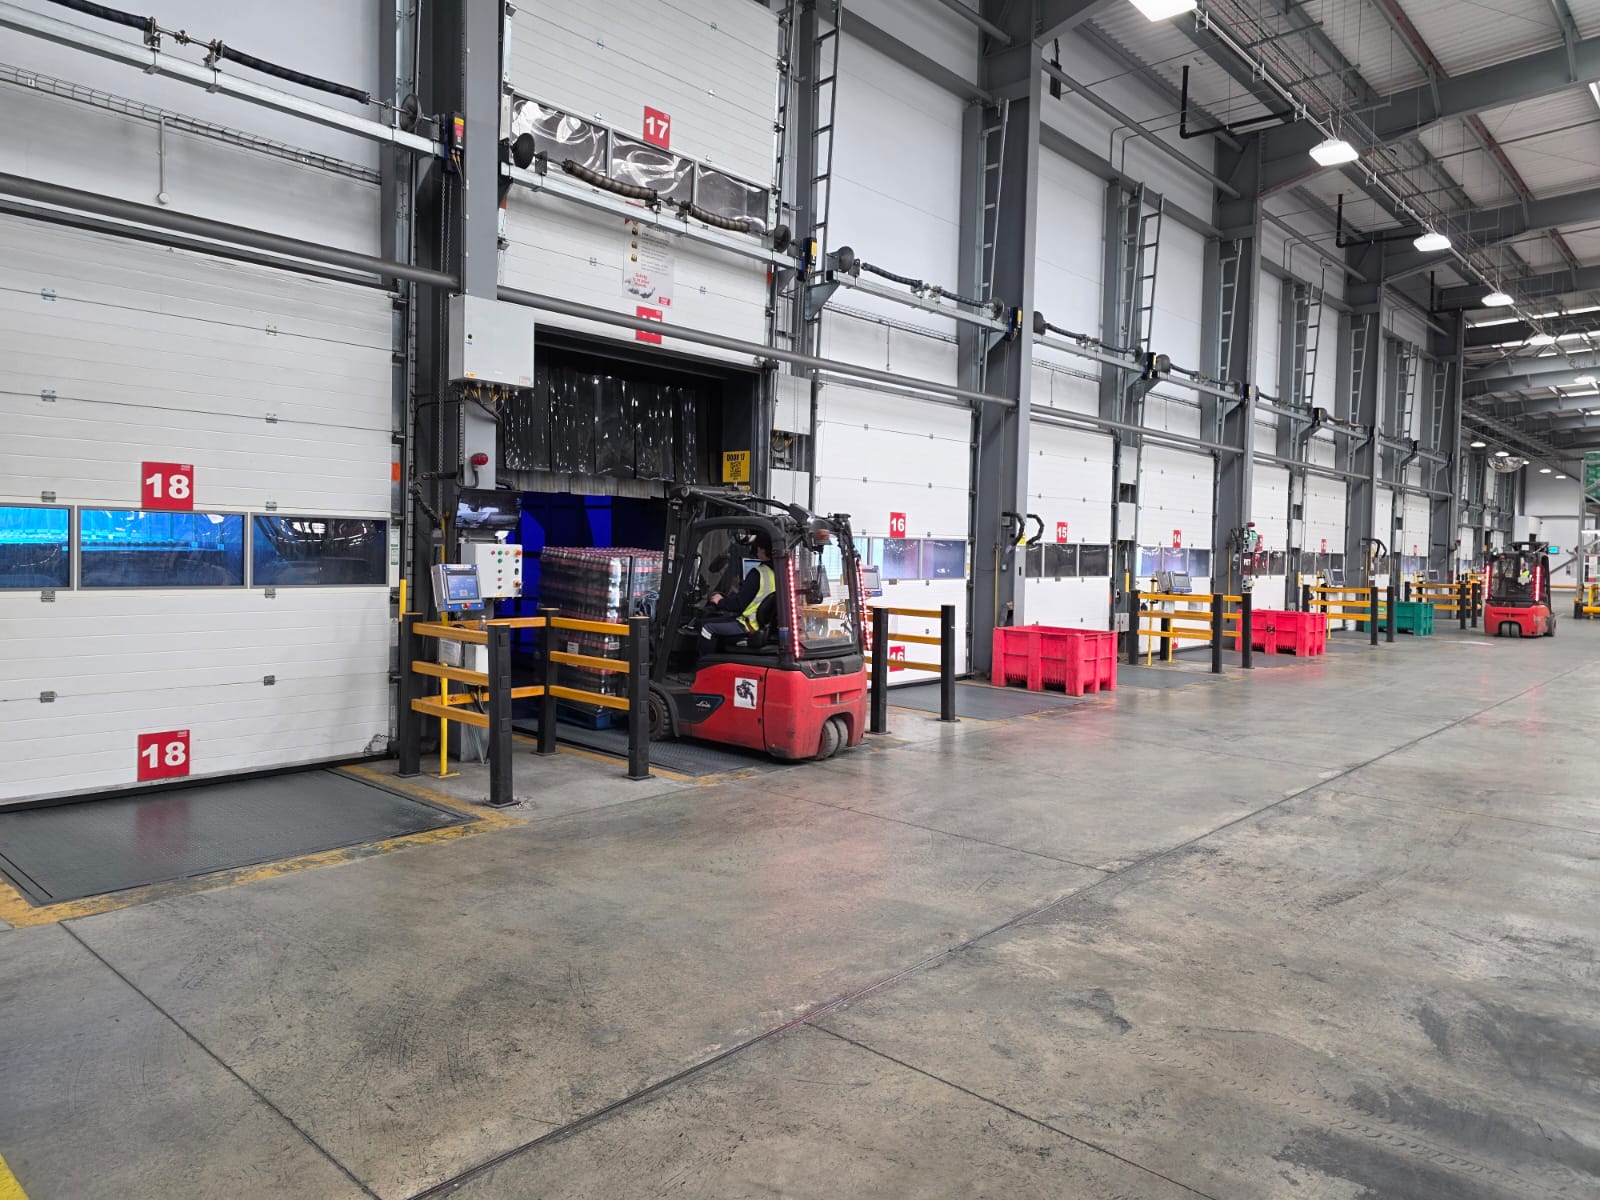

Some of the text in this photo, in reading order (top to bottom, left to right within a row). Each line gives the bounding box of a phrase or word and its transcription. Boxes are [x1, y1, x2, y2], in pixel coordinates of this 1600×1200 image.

[645, 116, 669, 139] 17
[145, 473, 190, 499] 18
[890, 517, 905, 532] 16
[1057, 526, 1067, 538] 15
[141, 741, 186, 769] 18
